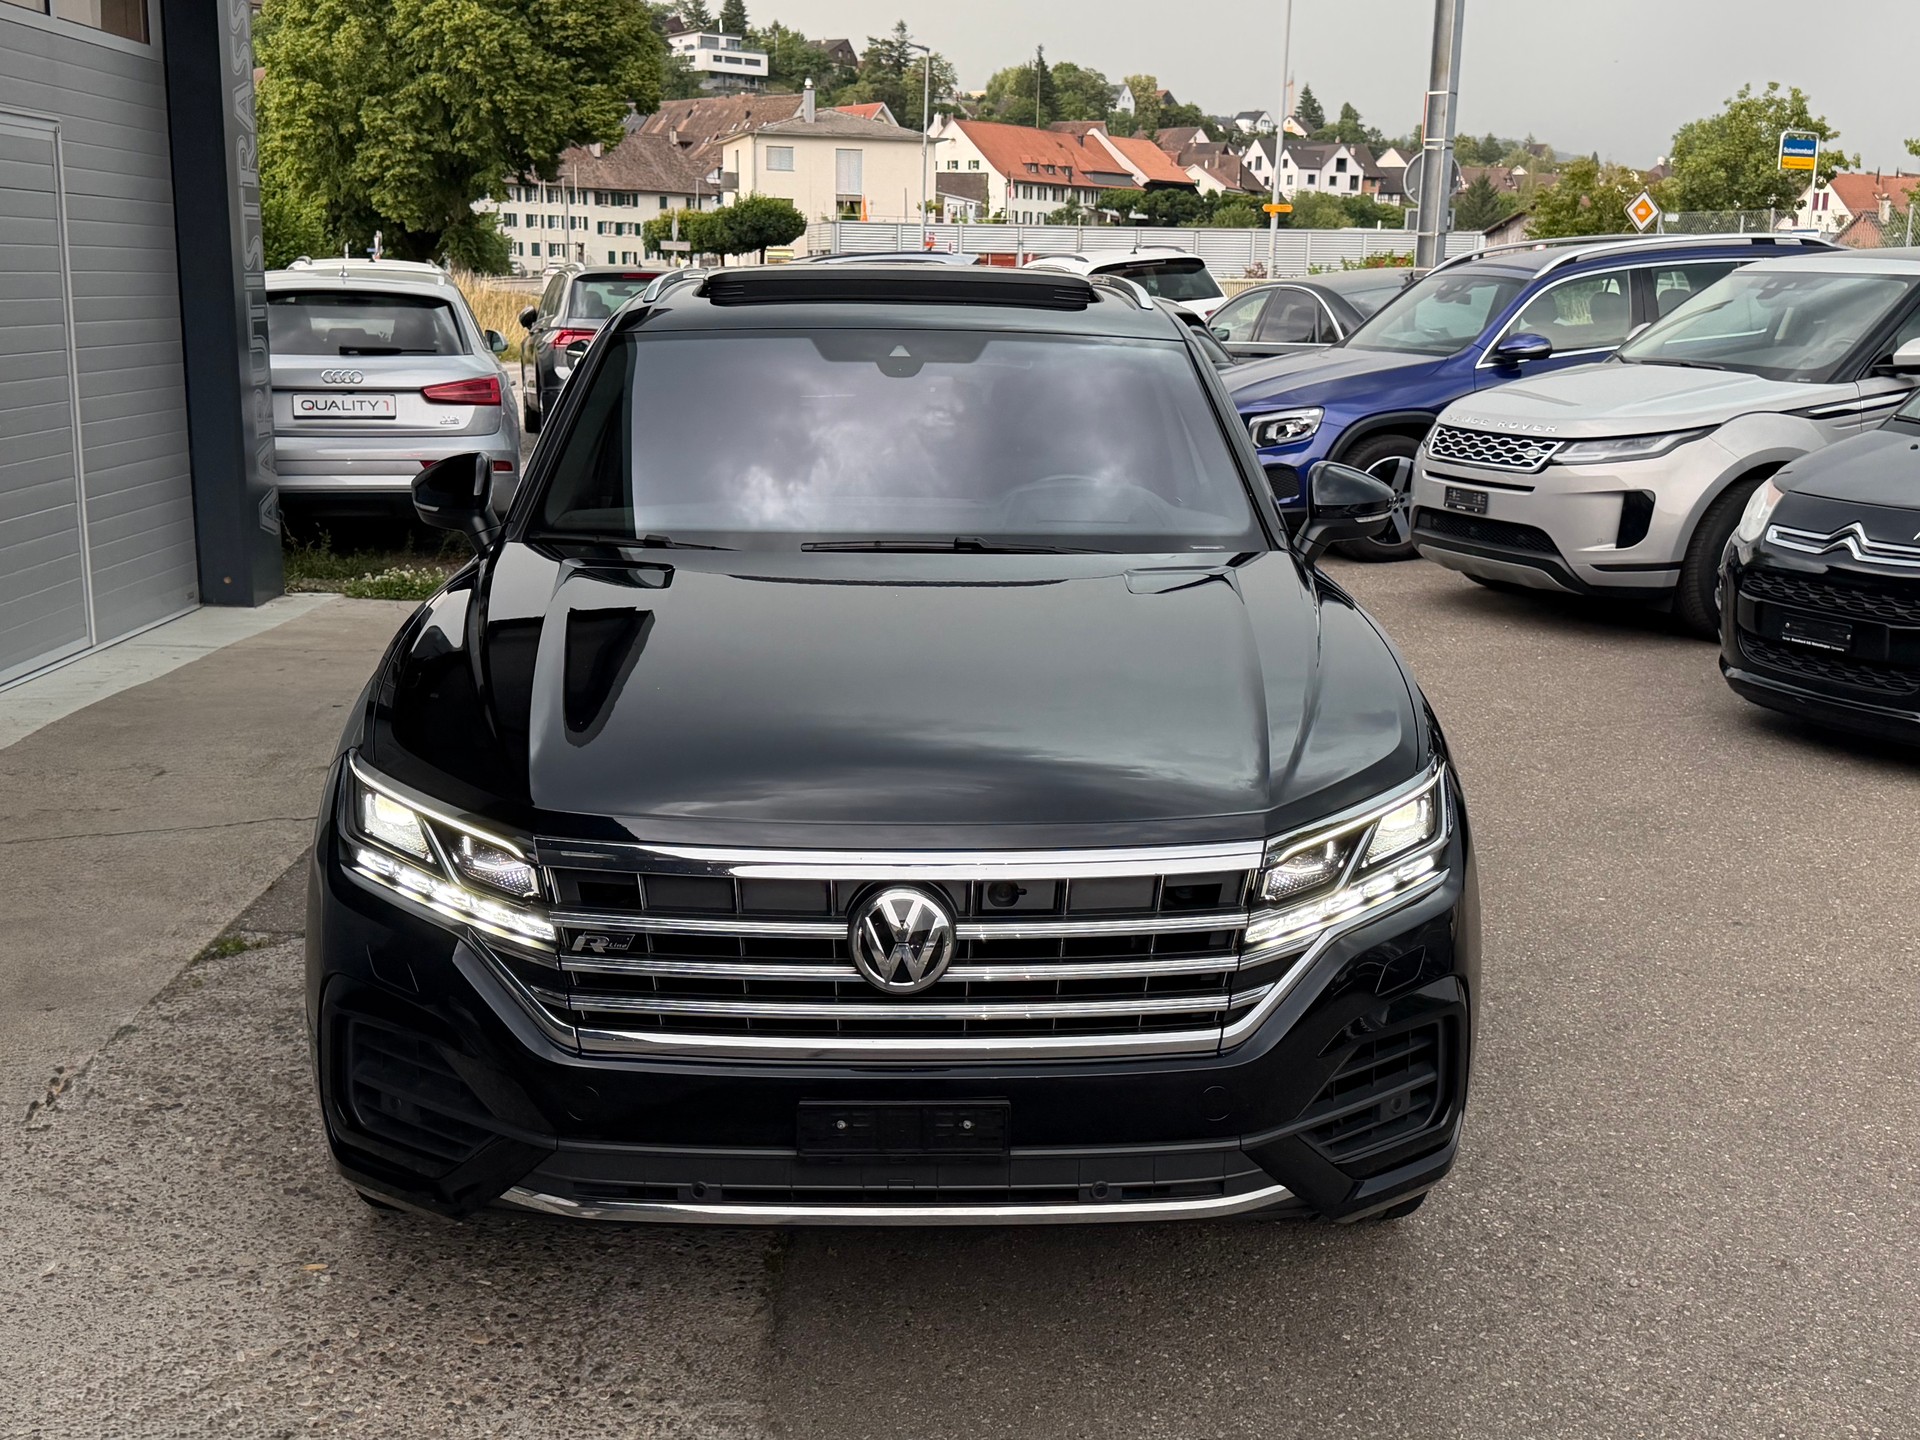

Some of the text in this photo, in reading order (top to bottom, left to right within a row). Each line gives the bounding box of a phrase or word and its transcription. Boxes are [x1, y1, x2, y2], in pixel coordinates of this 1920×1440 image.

[301, 399, 390, 412] QUALITY 1
[1496, 421, 1559, 433] ROVER
